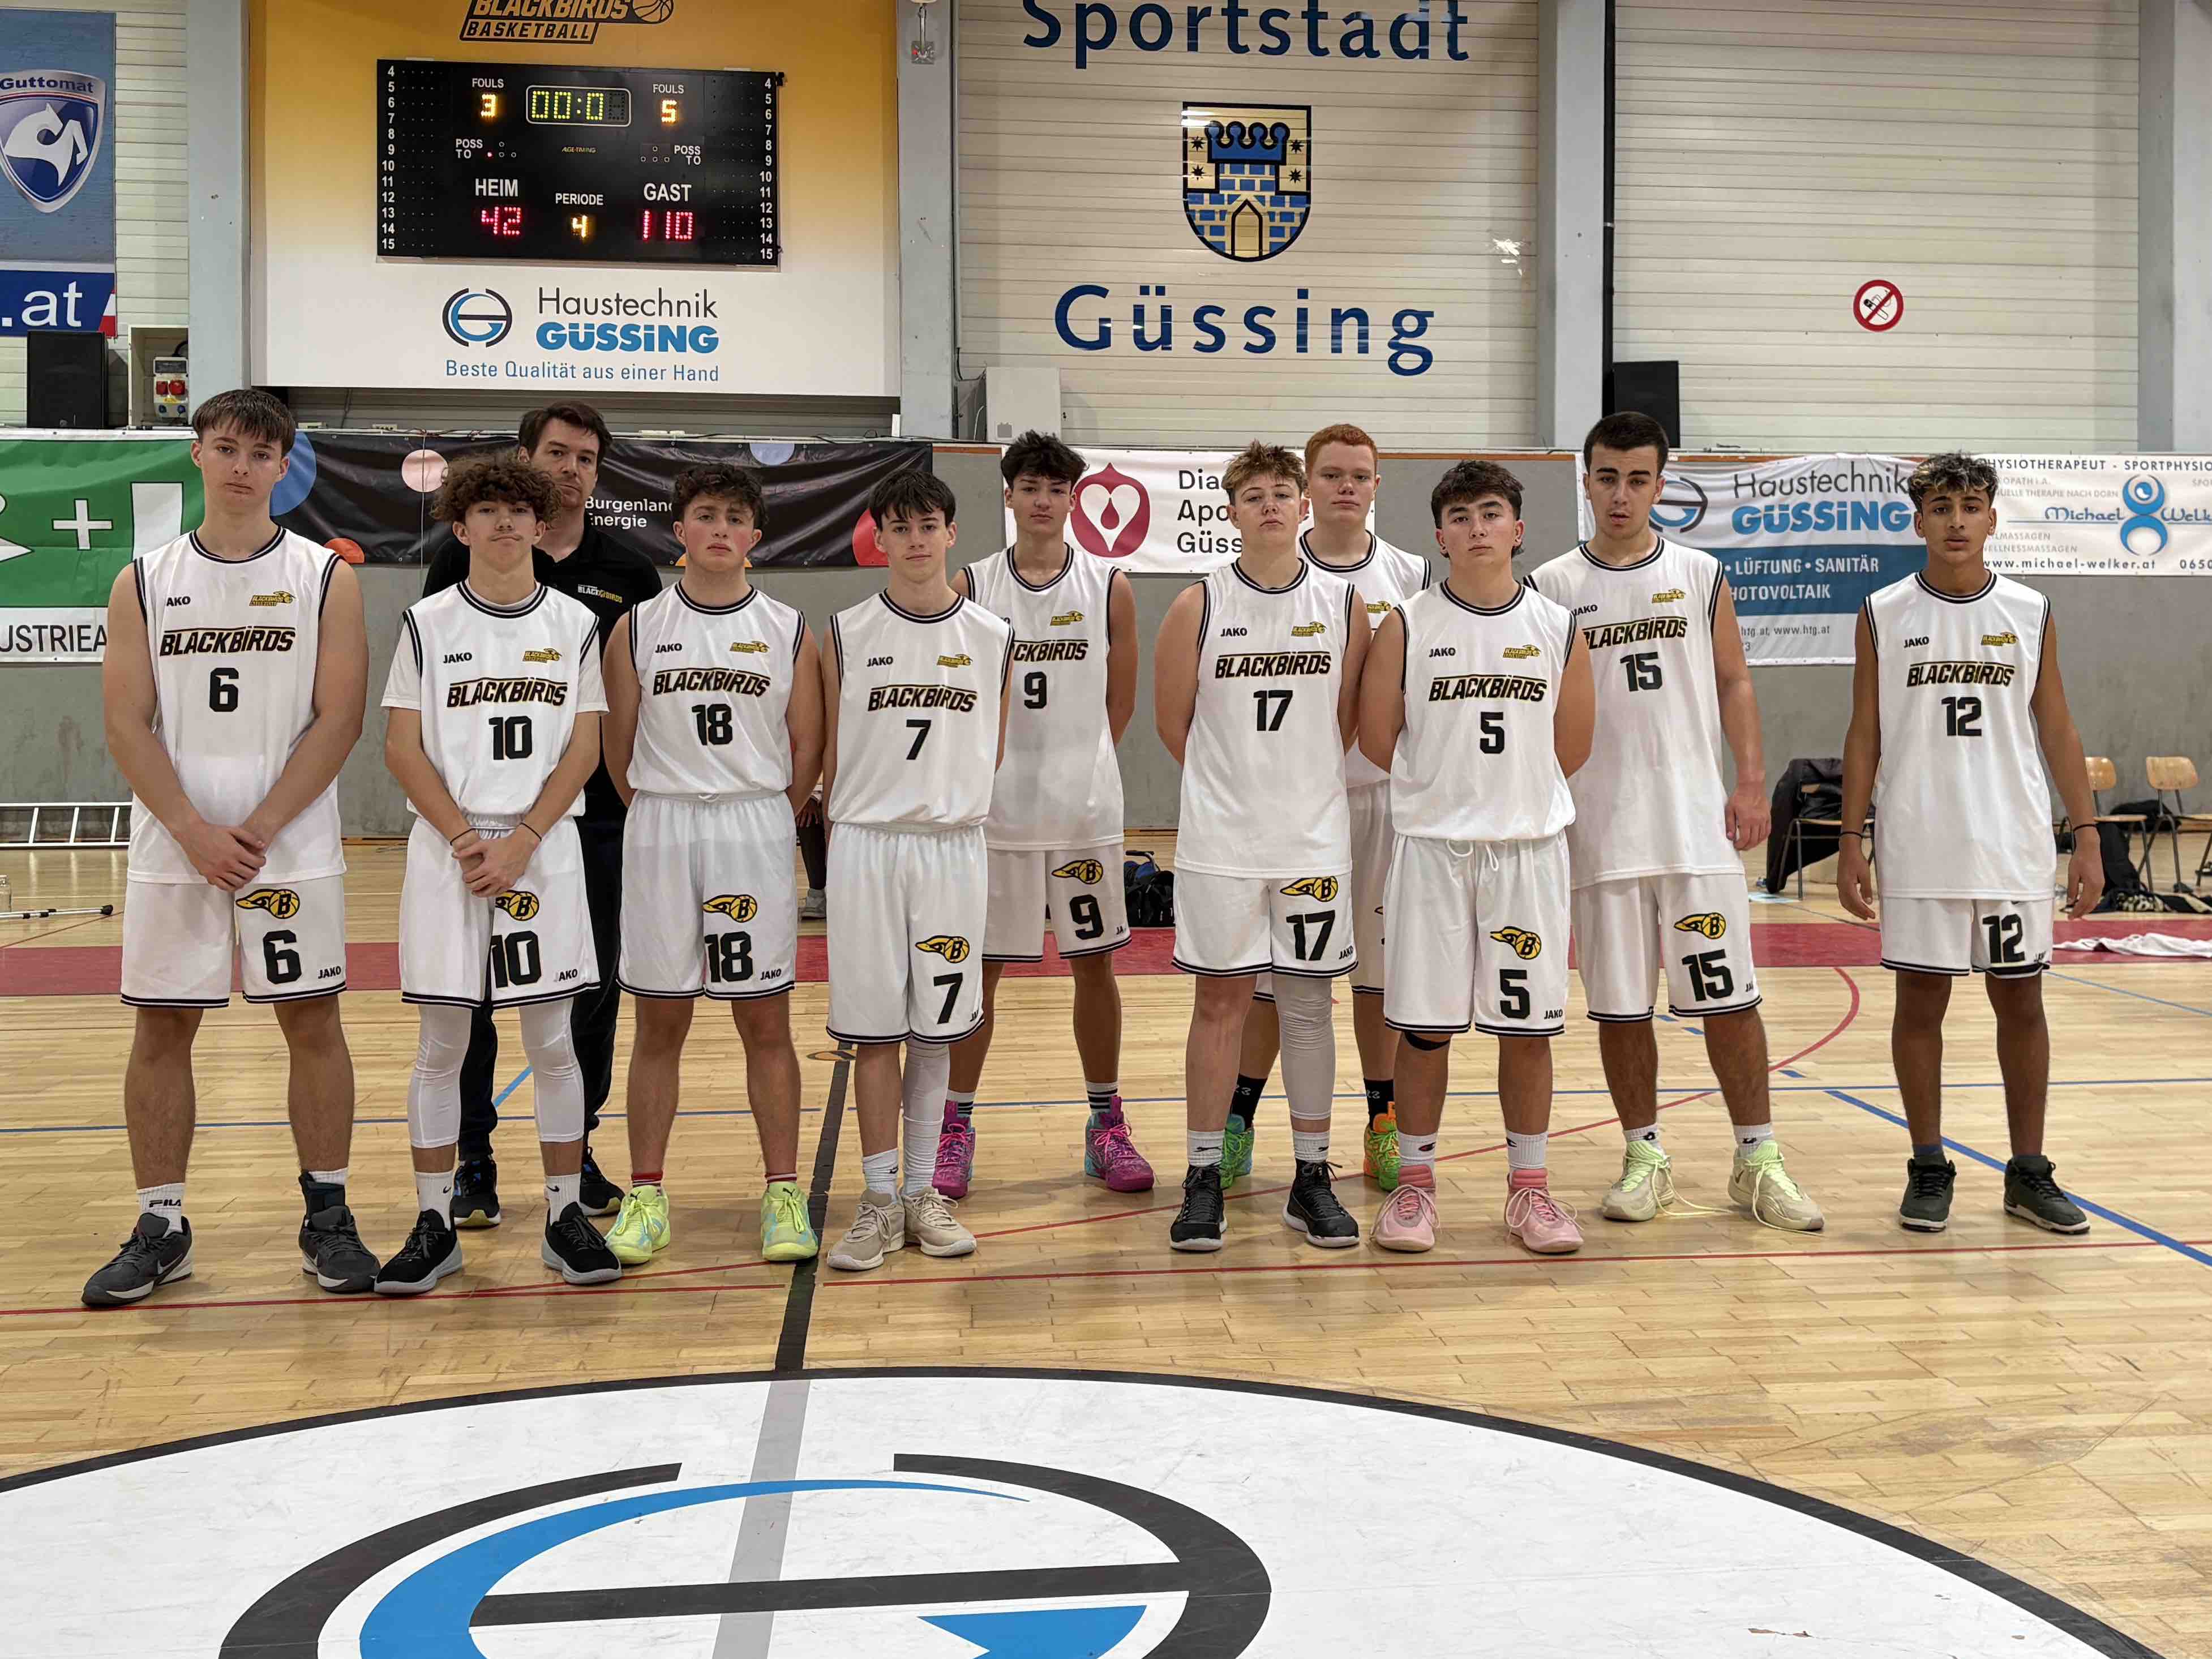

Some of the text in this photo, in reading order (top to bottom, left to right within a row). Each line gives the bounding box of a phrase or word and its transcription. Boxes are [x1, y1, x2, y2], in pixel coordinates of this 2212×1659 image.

[466, 21, 590, 39] BASKETBALL
[1023, 0, 1469, 69] Sportstadt
[388, 66, 395, 76] 4
[0, 76, 94, 93] Guttomat
[388, 82, 395, 92] 5
[472, 78, 504, 88] FOULS
[653, 84, 684, 93] FOULS
[765, 78, 771, 89] 4
[388, 97, 395, 108] 6
[481, 94, 496, 116] 3
[765, 94, 771, 104] 5
[388, 113, 395, 123] 7
[765, 109, 771, 119] 6
[388, 128, 395, 139] 8
[765, 125, 771, 135] 7
[388, 144, 395, 155] 9
[456, 139, 483, 149] POSS
[674, 145, 701, 155] POSS
[765, 140, 771, 151] 8
[456, 149, 471, 158] TO
[687, 156, 701, 165] TO
[765, 155, 771, 166] 9
[382, 160, 395, 171] 10
[382, 176, 393, 187] 11
[760, 172, 772, 182] 10
[475, 178, 518, 198] HEIM
[644, 183, 692, 203] GAST
[760, 187, 770, 198] 11
[382, 192, 395, 202] 12
[555, 193, 603, 206] PERIODE
[382, 207, 395, 218] 13
[760, 202, 772, 213] 12
[382, 223, 395, 233] 14
[481, 207, 521, 235] 42
[572, 215, 588, 237] 4
[643, 210, 693, 241] 110
[760, 218, 772, 228] 13
[382, 238, 395, 249] 15
[760, 233, 772, 243] 14
[760, 249, 772, 259] 15
[2, 281, 82, 327] .at
[539, 288, 718, 319] Haustechnik
[1055, 284, 1434, 377] Güssing
[446, 360, 719, 382] Beste Qualität aus einer Hand
[1178, 468, 1223, 490] Dia
[1734, 461, 1910, 499] Haustechnik
[2044, 507, 2124, 521] Michael
[1736, 555, 1879, 575] LÜFTUNG SANITÄR
[1220, 627, 1248, 637] JAKO
[160, 629, 295, 657] BLACKBIRDS
[655, 643, 682, 653] JAKO
[1904, 636, 1929, 648] JAKO
[443, 652, 472, 663] JAKO
[1013, 642, 1088, 662] CKBIRDS
[1429, 648, 1456, 658] JAKO
[867, 656, 893, 667] JAKO
[1215, 655, 1332, 679] BLACKBIRDS
[1620, 651, 1662, 692] 15
[1906, 664, 2014, 688] BLACKBIRDS
[209, 667, 239, 711] 6
[653, 671, 770, 697] BLACKBIRDS
[1024, 671, 1047, 709] 9
[1429, 678, 1547, 701] BLACKBIRDS
[447, 680, 568, 707] BLACKBIRDS
[868, 688, 978, 712] BLACKBIRDS
[1253, 690, 1293, 731] 17
[1941, 697, 1982, 736] 12
[692, 704, 733, 745] 18
[488, 715, 532, 760] 10
[906, 719, 932, 760] 7
[1480, 711, 1504, 754] 5
[1069, 894, 1104, 941] 9
[1286, 910, 1335, 961] 17
[1982, 914, 2025, 963] 12
[263, 929, 302, 985] 6
[490, 930, 542, 988] 10
[705, 930, 755, 983] 18
[318, 965, 341, 979] JAKO
[760, 967, 782, 981] JAKO
[1682, 949, 1735, 1002] 15
[933, 972, 963, 1024] 7
[1499, 969, 1529, 1019] 5
[1544, 1009, 1563, 1020] JAKO
[149, 1199, 181, 1208] FILA
